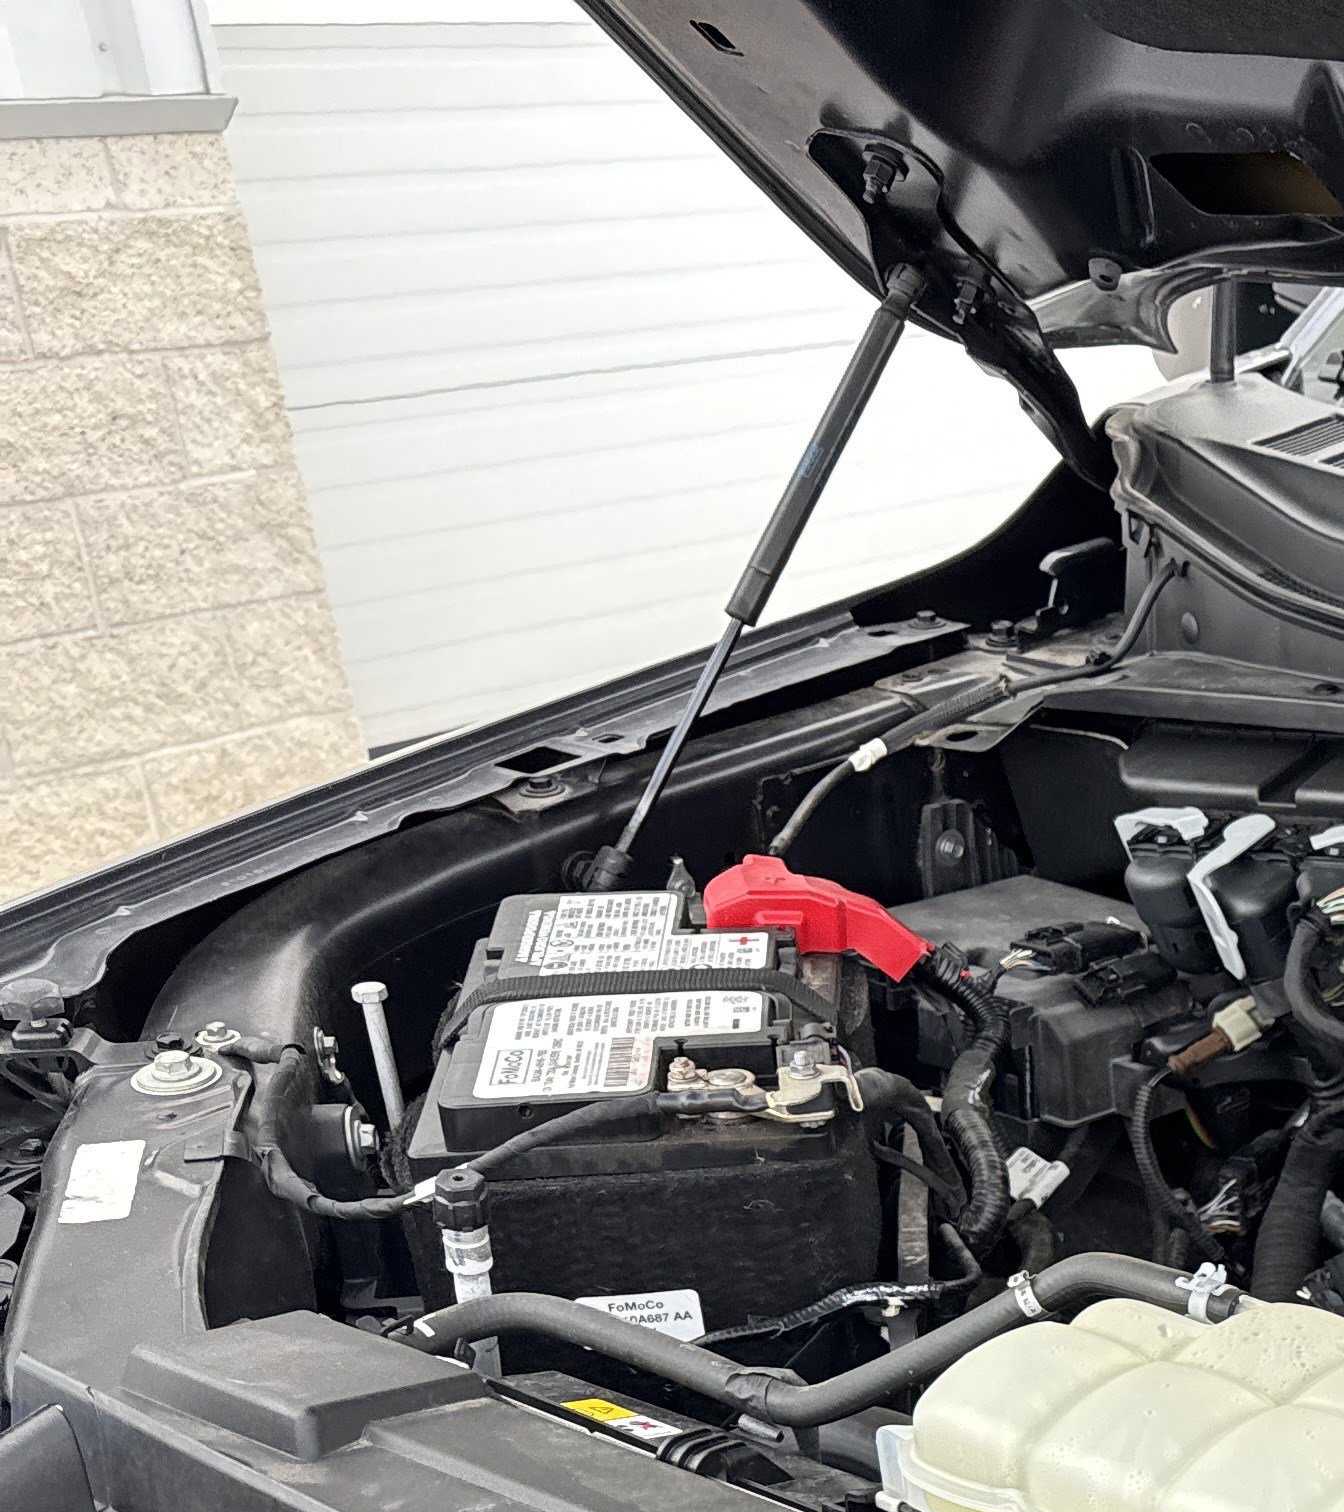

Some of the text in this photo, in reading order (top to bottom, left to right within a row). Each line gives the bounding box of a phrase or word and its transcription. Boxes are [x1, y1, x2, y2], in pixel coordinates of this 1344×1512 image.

[498, 1050, 526, 1086] FoMoCo
[607, 1300, 665, 1313] FoMoCo
[673, 1310, 693, 1322] AA
